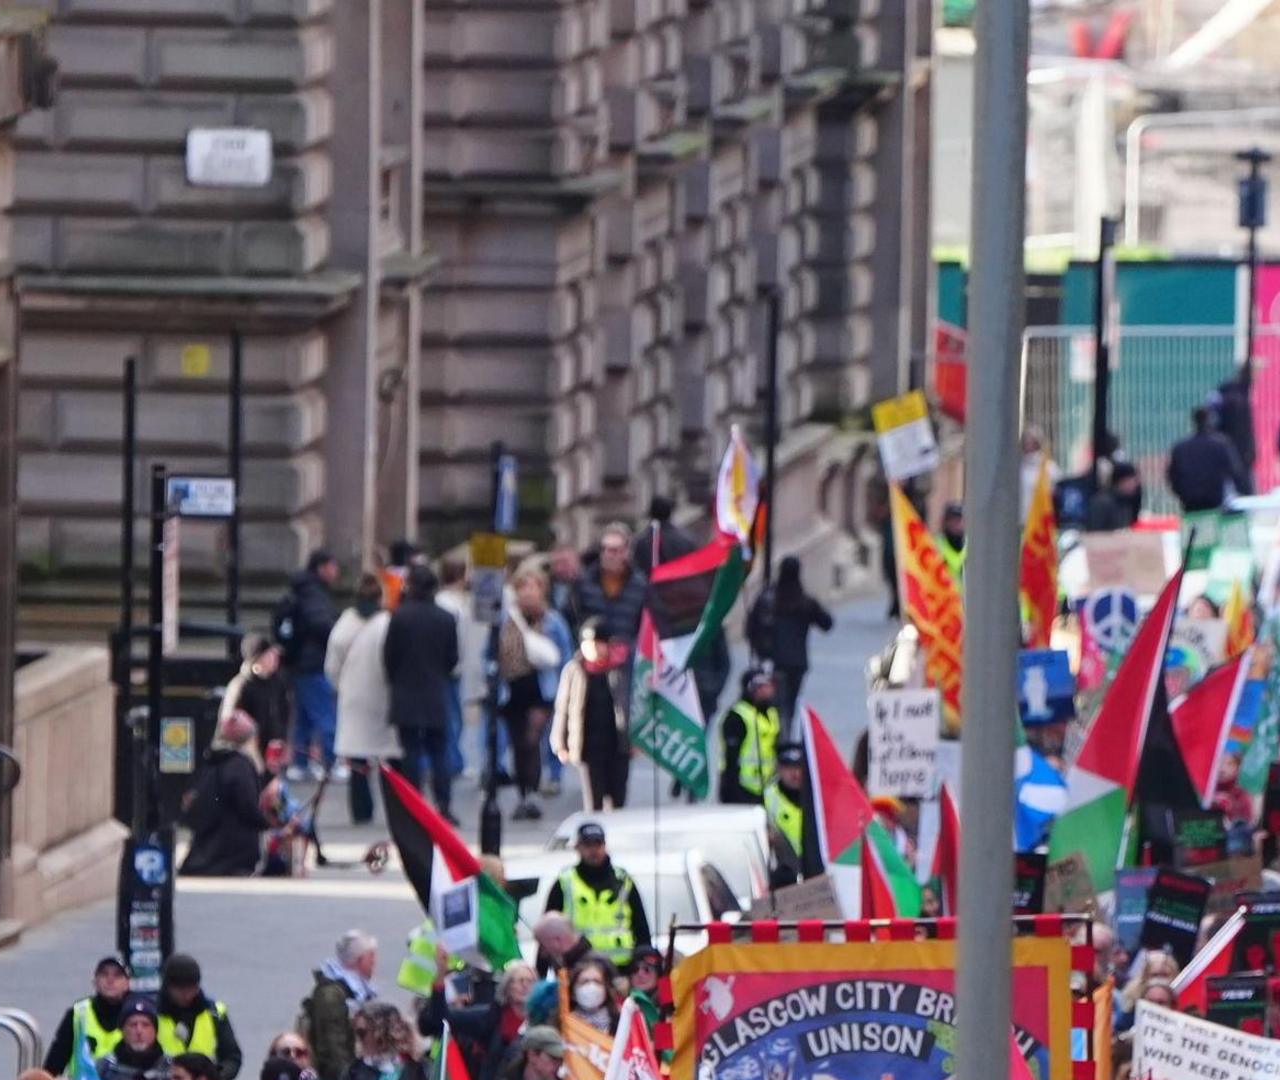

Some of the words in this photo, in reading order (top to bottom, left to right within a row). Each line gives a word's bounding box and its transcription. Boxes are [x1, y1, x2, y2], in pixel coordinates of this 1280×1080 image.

[701, 986, 828, 1070] GLASGOW
[835, 982, 905, 1011] CITY
[806, 1022, 924, 1058] UNISON
[1144, 1026, 1174, 1044] IT'S
[1181, 1037, 1209, 1056] THE
[1144, 1046, 1182, 1067] WHO
